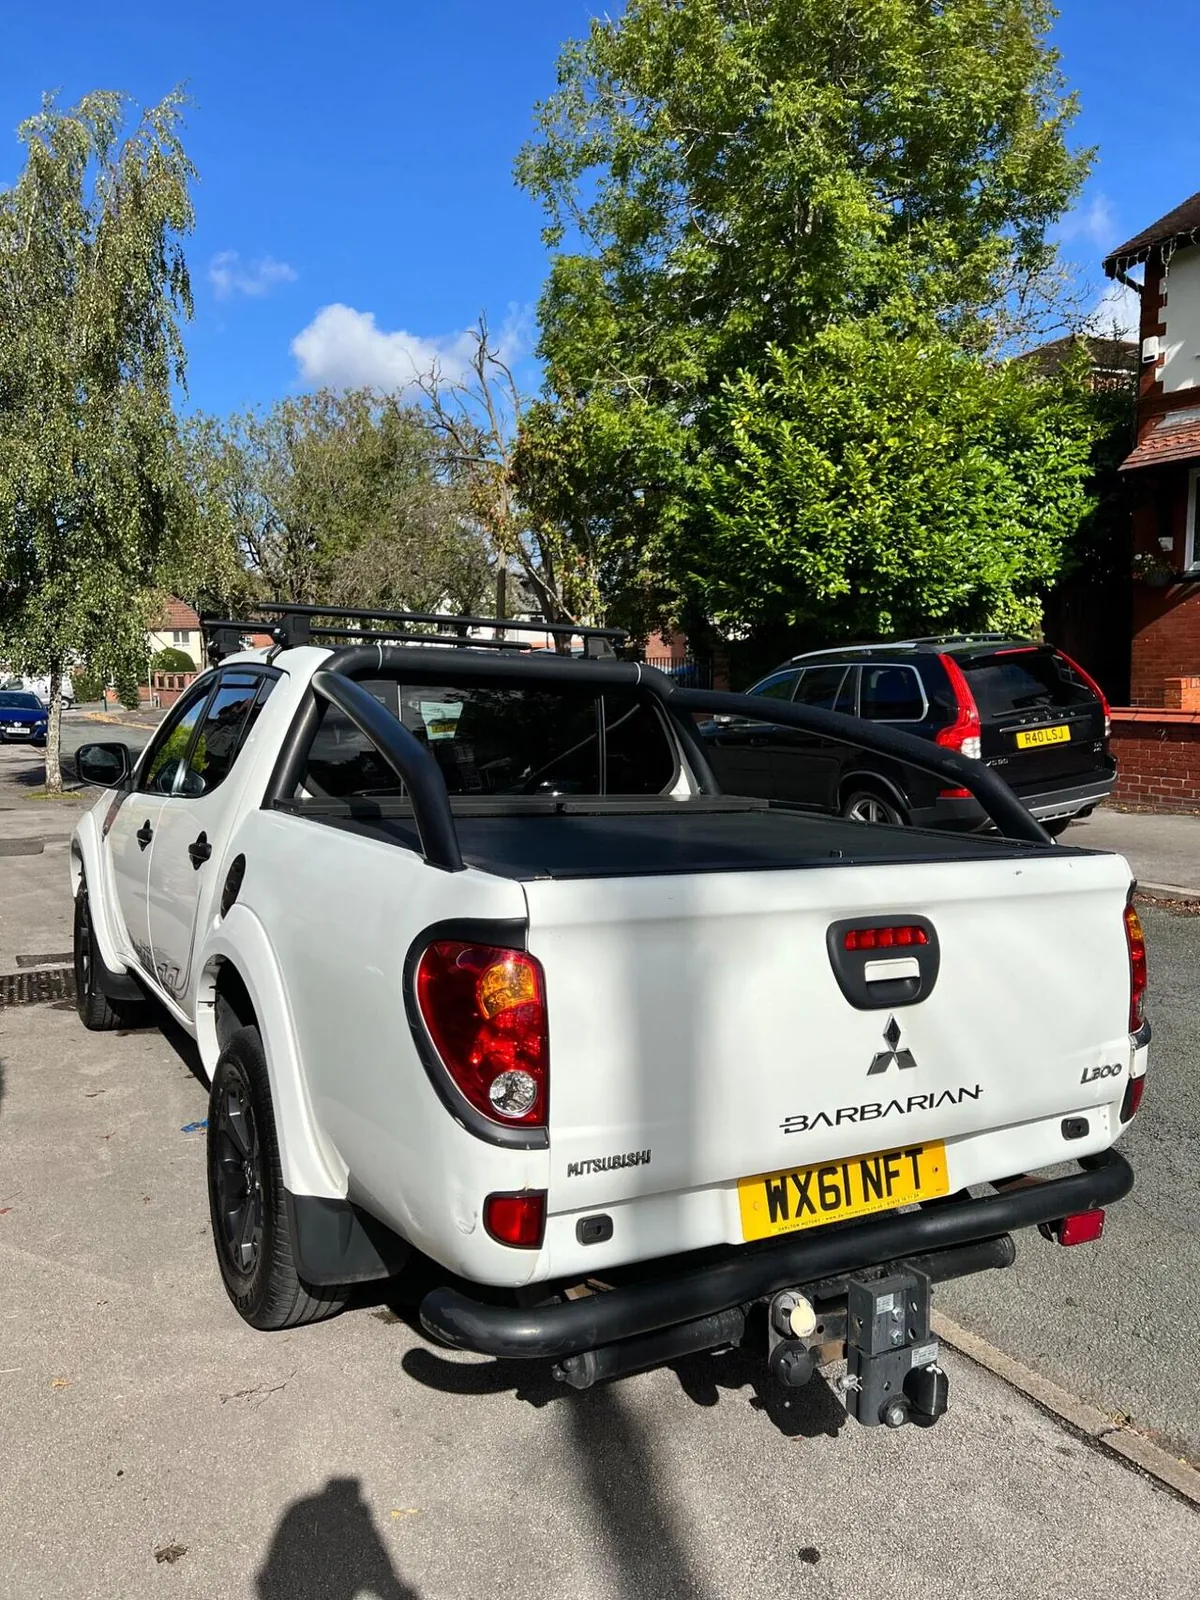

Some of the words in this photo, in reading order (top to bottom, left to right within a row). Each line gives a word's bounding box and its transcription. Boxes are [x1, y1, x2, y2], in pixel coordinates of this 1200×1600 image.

[1025, 730, 1044, 744] R40
[1046, 728, 1064, 741] LSJ
[779, 1084, 983, 1134] BARBARIAN
[567, 1149, 651, 1178] MITSUBISHI
[764, 1163, 852, 1223] WX61
[860, 1147, 923, 1203] NFT
